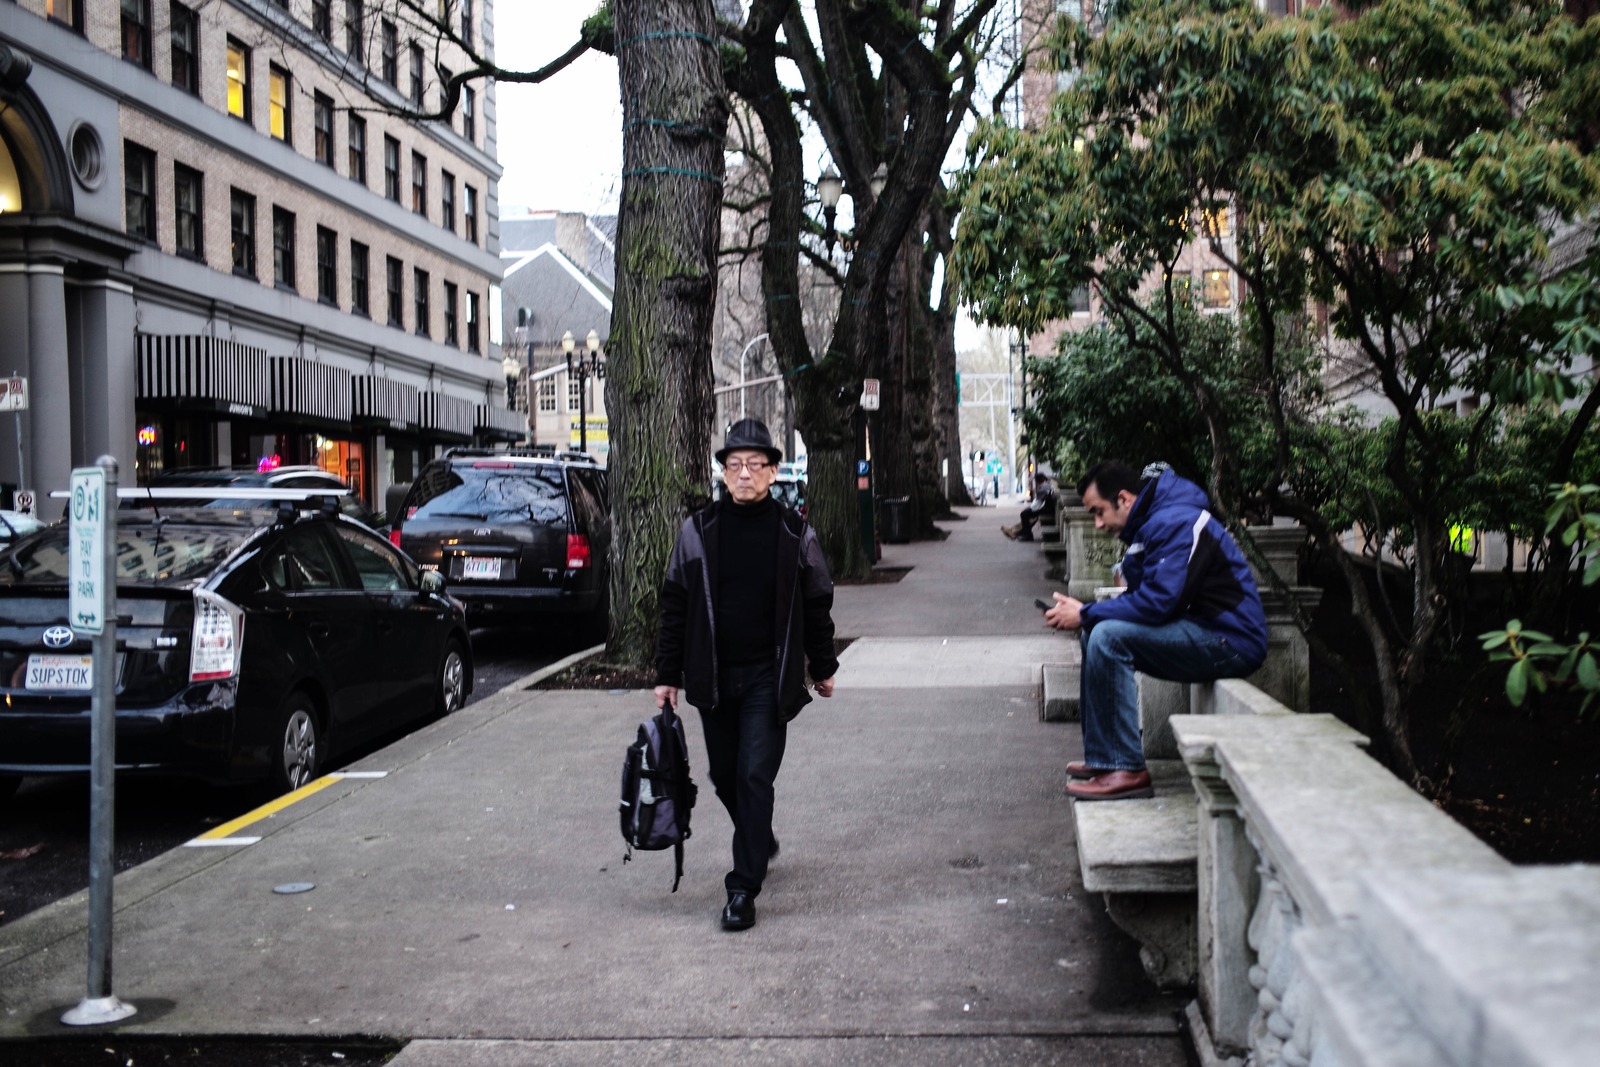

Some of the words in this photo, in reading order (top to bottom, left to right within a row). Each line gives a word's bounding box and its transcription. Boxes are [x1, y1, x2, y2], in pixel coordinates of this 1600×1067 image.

[80, 540, 92, 557] PAY
[82, 560, 91, 577] TO
[78, 580, 95, 599] PARK
[31, 668, 88, 684] SUPSTOK
